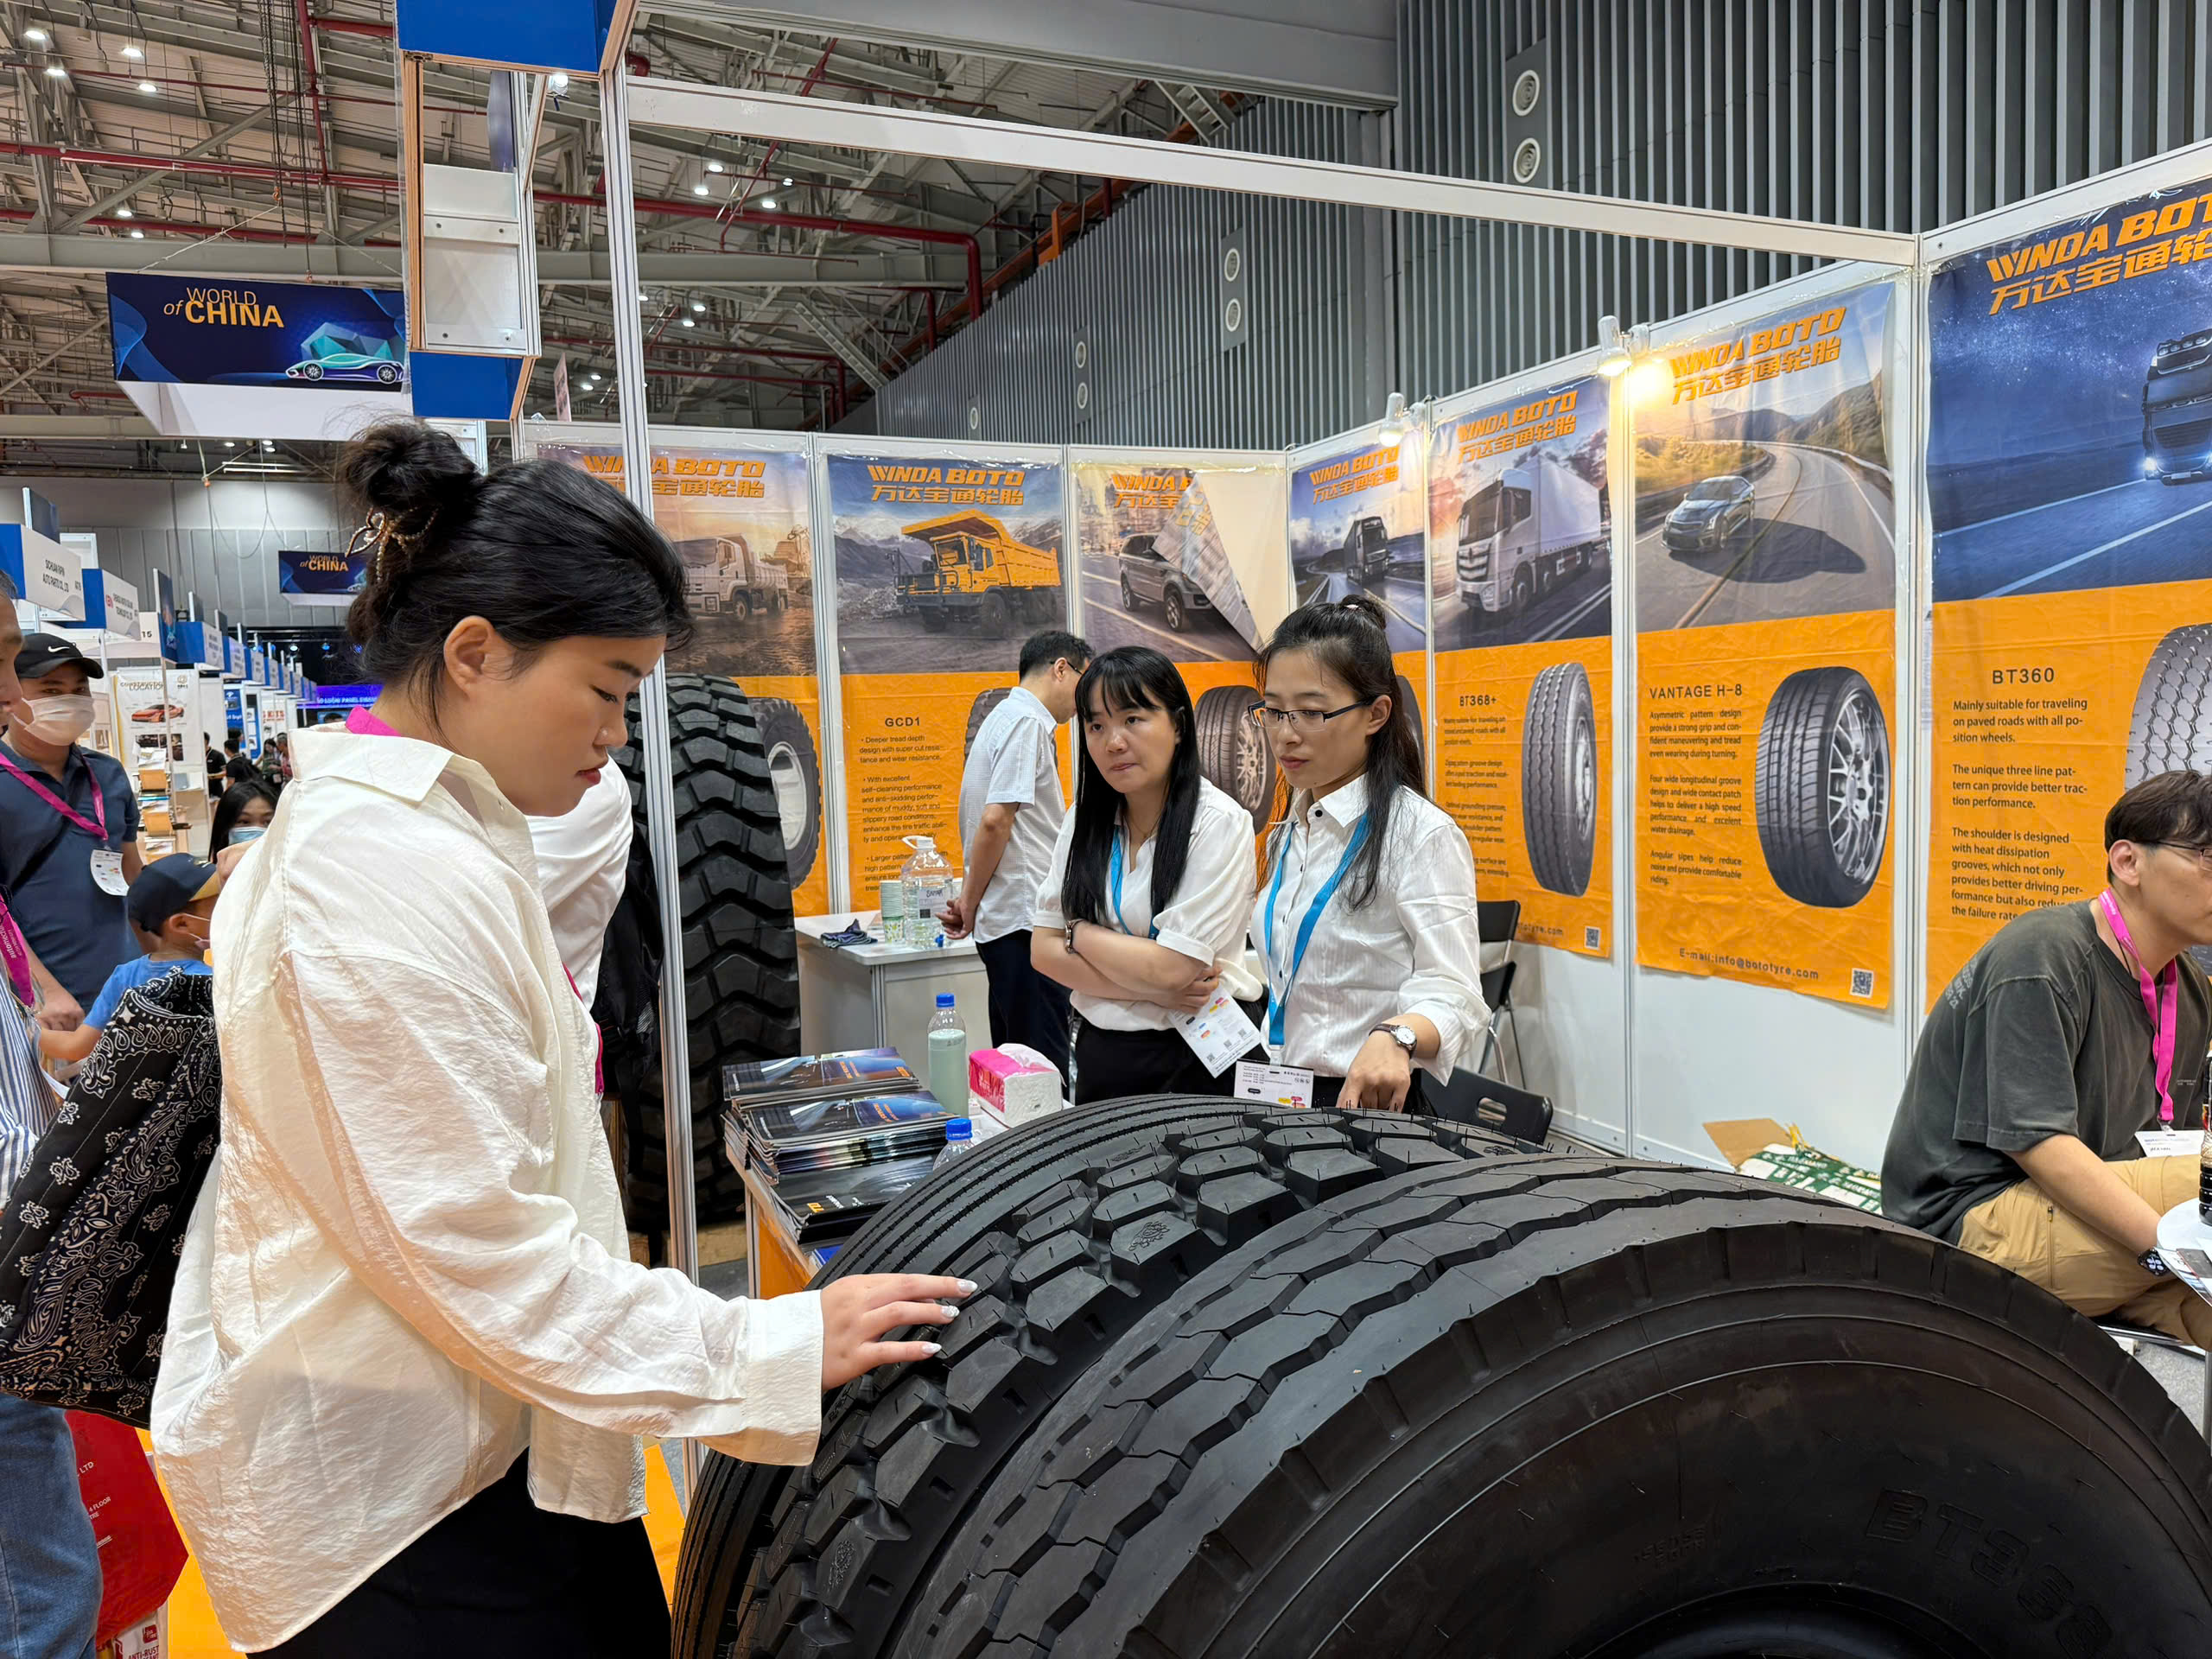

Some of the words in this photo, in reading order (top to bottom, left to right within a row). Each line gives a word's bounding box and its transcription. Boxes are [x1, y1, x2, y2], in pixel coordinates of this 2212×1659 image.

[1986, 224, 2108, 283] WINDA
[187, 288, 257, 306] WORLD
[163, 300, 184, 315] of
[185, 301, 284, 327] CHINA
[1669, 339, 1745, 378] WINDA
[1748, 307, 1847, 356] BOTO
[1672, 336, 1841, 404] 万达宝通轮胎
[1458, 411, 1509, 442] WINDA
[1511, 391, 1578, 427] BOTO
[1459, 414, 1576, 463] 万达宝通轮胎
[583, 455, 670, 474] WINA
[673, 459, 766, 478] BOTO
[1309, 461, 1350, 486] WINDA
[1352, 444, 1400, 474] BOTO
[867, 465, 945, 485] WINDA
[946, 468, 1025, 486] BOTO
[1111, 474, 1175, 491] WINDA
[1313, 464, 1399, 505] 万达宝通轮胎
[871, 486, 1024, 505] 万达宝通轮胎
[308, 561, 348, 571] CHINA
[1993, 667, 2055, 684] BT360
[1649, 685, 1712, 698] VANTAGE
[1717, 684, 1742, 696] H-8
[1459, 695, 1497, 707] BT368+
[1953, 700, 1985, 712] Mainly
[1986, 699, 2024, 710] suitable
[2025, 699, 2039, 709] for
[2042, 698, 2088, 710] traveling
[885, 717, 920, 727] GCD1
[1649, 711, 1685, 720] Asymmetric
[1690, 710, 1713, 719] pattern
[1719, 710, 1741, 719] design
[1967, 716, 1995, 728] paved
[1998, 715, 2024, 726] roads
[2027, 715, 2049, 725] with
[2051, 715, 2063, 725] all
[2066, 716, 2082, 728] po-
[1953, 734, 1978, 742] sition
[1980, 733, 2015, 742] wheels.
[1953, 764, 1969, 774] The
[1972, 766, 2004, 777] unique
[2006, 766, 2032, 775] three
[2034, 766, 2053, 776] line
[2055, 766, 2075, 778] pat-
[1953, 781, 1971, 791] tern
[1992, 782, 2029, 792] provide
[2031, 783, 2062, 793] better
[2064, 784, 2088, 793] trac-
[1953, 797, 1970, 806] tion
[1973, 798, 2036, 809] performance.
[1953, 827, 1969, 837] The
[1971, 828, 2012, 841] shoulder
[2013, 830, 2021, 841] is
[2023, 831, 2069, 844] designed
[1952, 844, 1972, 854] with
[1974, 845, 1994, 855] heat
[1997, 845, 2050, 859] dissipation
[1952, 861, 1989, 872] grooves,
[1992, 863, 2021, 874] which
[2023, 865, 2040, 875] not
[2042, 866, 2065, 878] only
[1952, 876, 1990, 887] provides
[1992, 878, 2023, 889] better
[2024, 880, 2059, 895] driving
[2062, 883, 2083, 895] per-
[1952, 889, 1993, 903] formance
[1996, 893, 2013, 905] but
[2015, 895, 2035, 906] also
[1952, 906, 1967, 916] the
[1968, 906, 1997, 919] failure
[79, 1461, 93, 1473] LTD
[92, 1497, 111, 1510] FLOOR
[129, 1645, 159, 1659] ANTI-RUST
